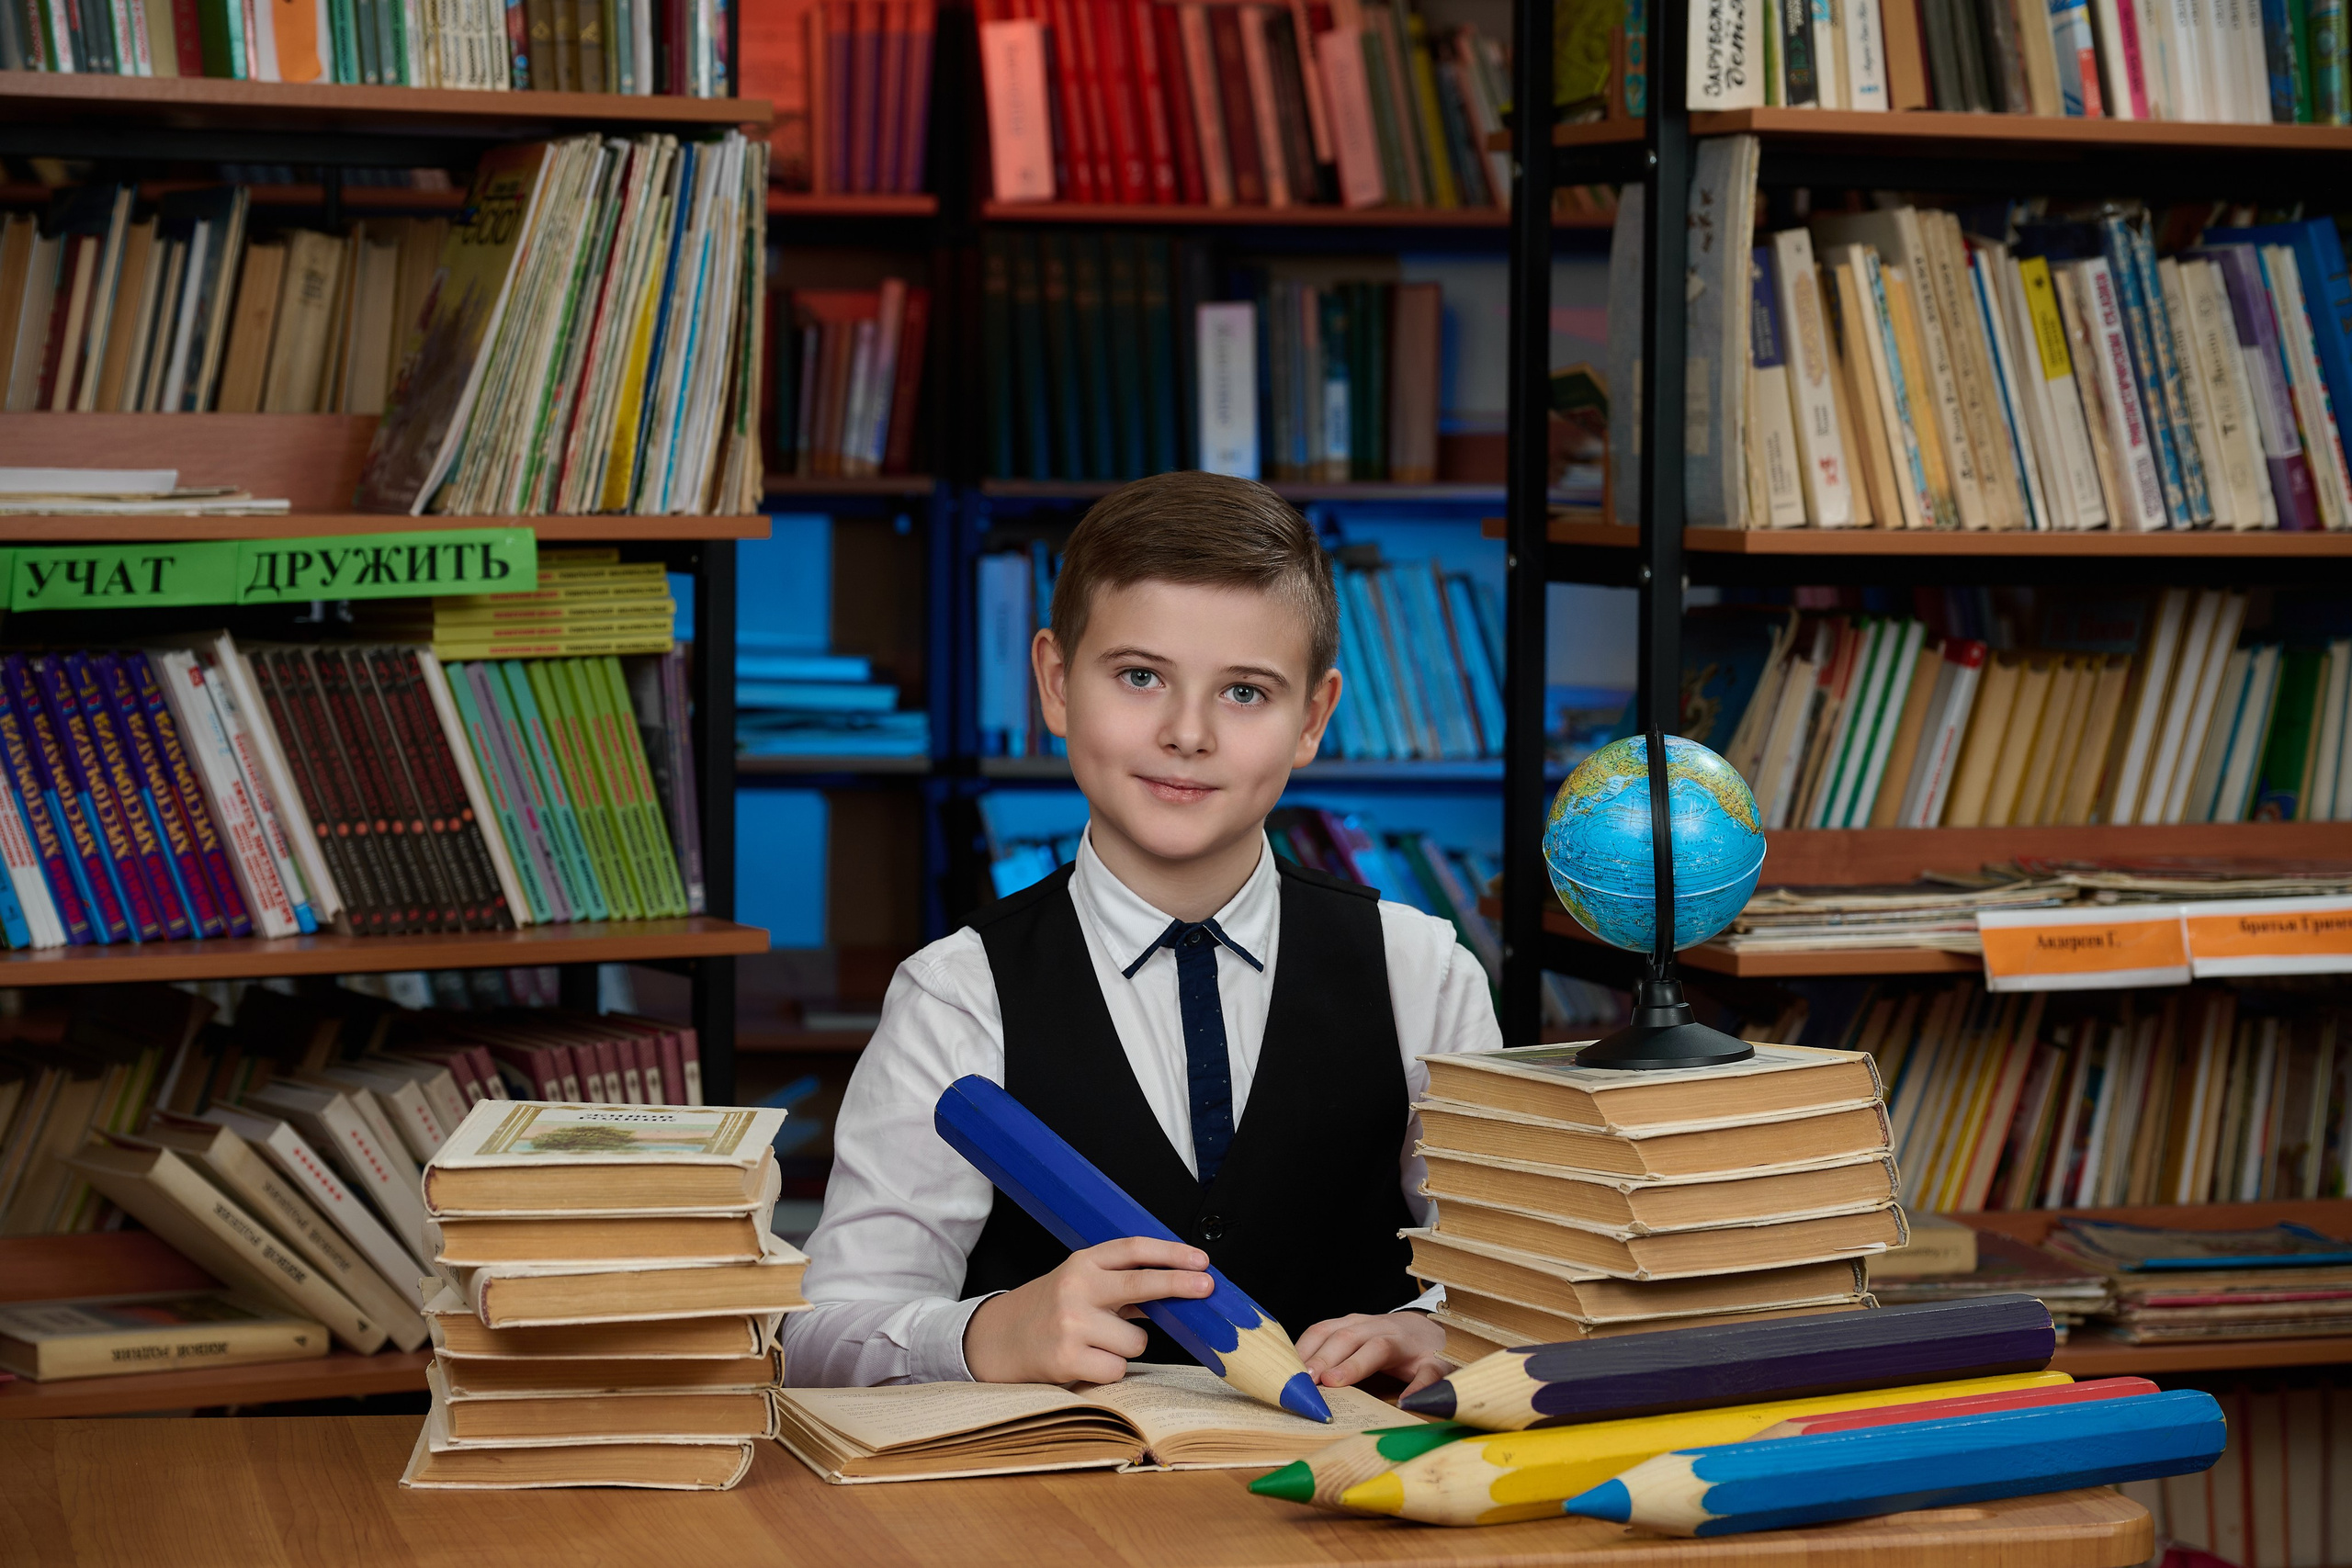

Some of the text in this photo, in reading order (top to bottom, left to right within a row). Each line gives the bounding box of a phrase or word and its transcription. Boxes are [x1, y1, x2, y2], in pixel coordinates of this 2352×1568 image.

[1703, 0, 1722, 96] ЗАРУБЕЖ
[25, 556, 175, 598] УЧАТ
[243, 542, 511, 599] ДРУЖИТЬ
[0, 712, 62, 861] ХРЕСТОМАТИЯ
[28, 711, 101, 859] ХРЕСТОМАТИЯ
[64, 713, 134, 861] ХРЕСТОМАТИЯ
[89, 709, 159, 857] ХРЕСТОМАТИЯ
[123, 710, 193, 857] ХРЕСТОМАТИЯ
[150, 708, 220, 854] ХРЕСТОМАТИЯ
[214, 1201, 260, 1247] РОДНИК
[263, 1243, 307, 1285] ЖИВОЙ
[111, 1345, 170, 1361] РОДНИК
[177, 1342, 228, 1359] ЖИВОЙ
